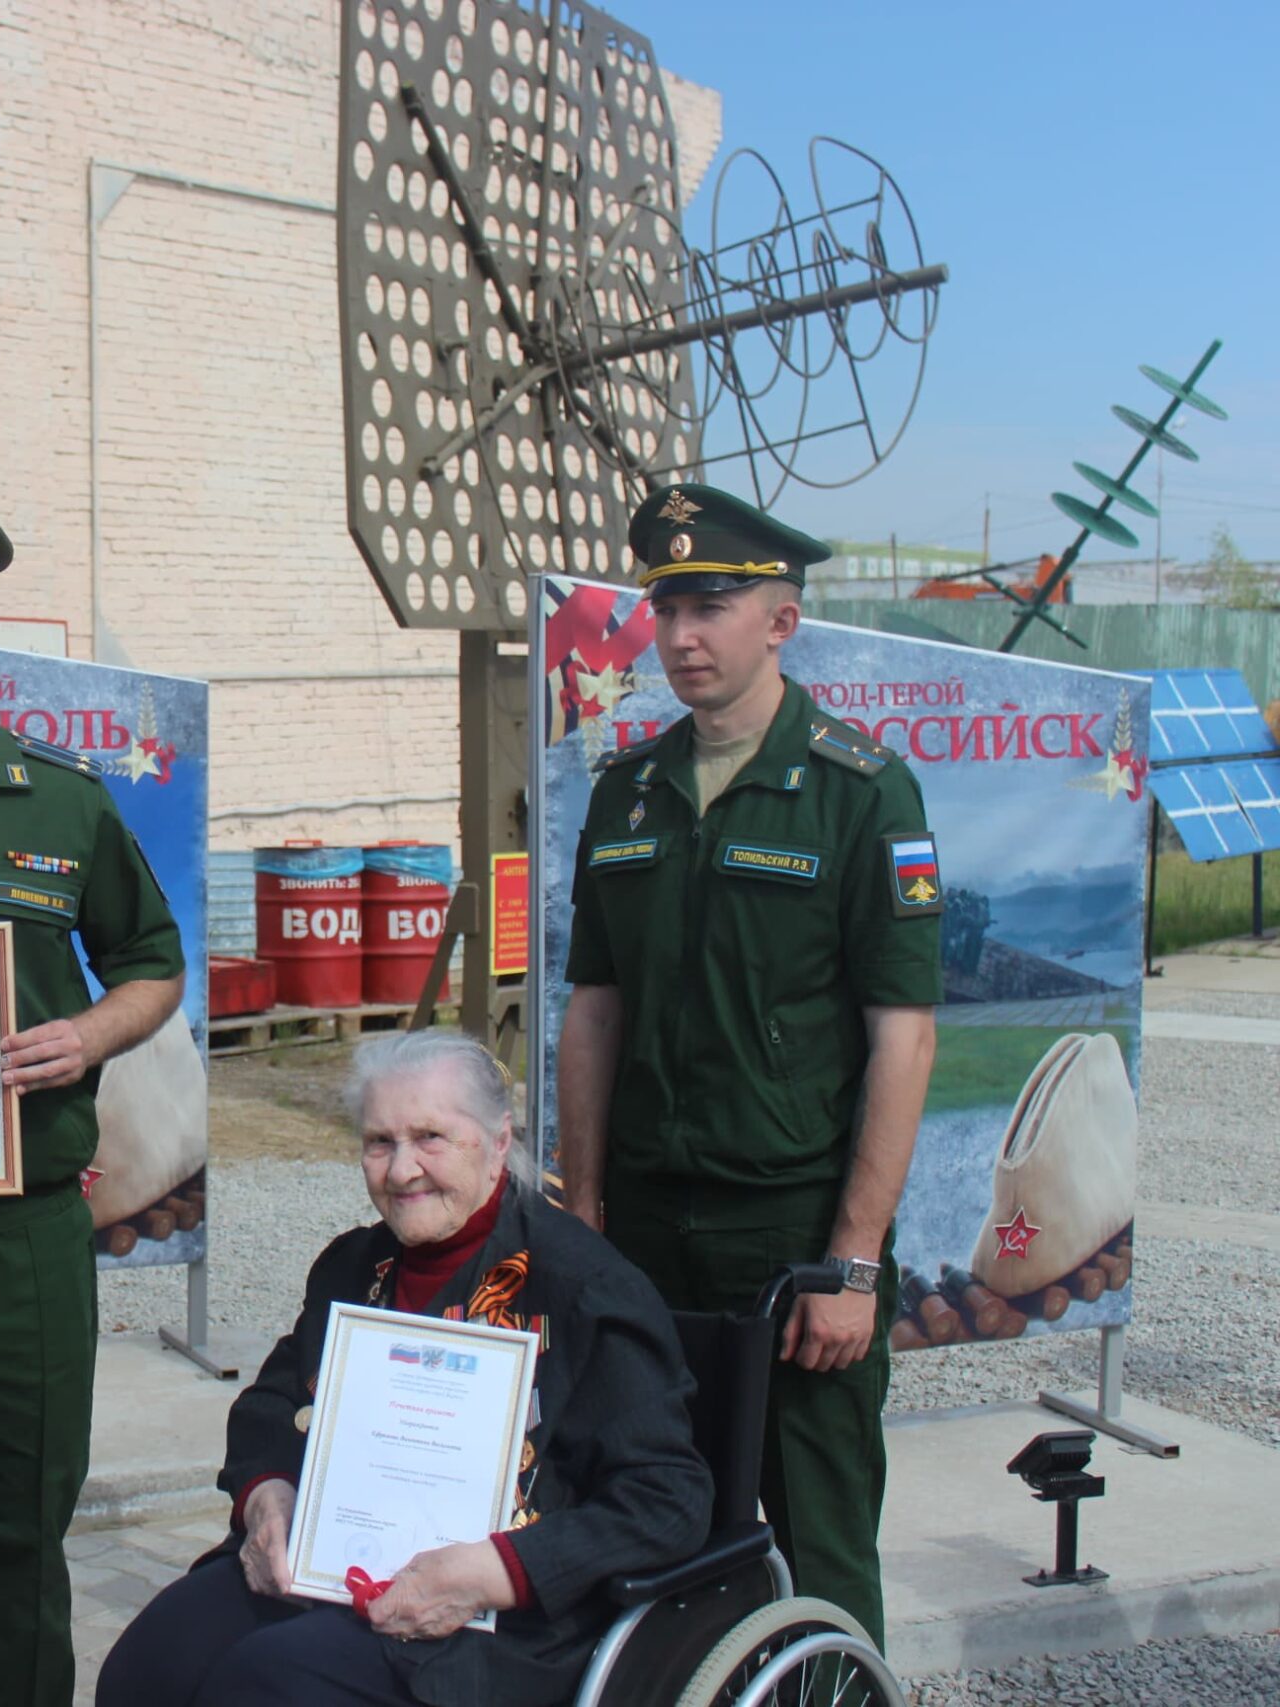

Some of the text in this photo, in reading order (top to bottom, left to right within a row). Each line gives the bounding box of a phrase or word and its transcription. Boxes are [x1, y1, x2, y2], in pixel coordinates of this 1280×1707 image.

[804, 676, 964, 712] РОД-ГЕРОЙ
[733, 850, 790, 868] ТОПИЛЬСКИЙ
[282, 907, 362, 944] ВОД
[388, 907, 448, 940] ВО
